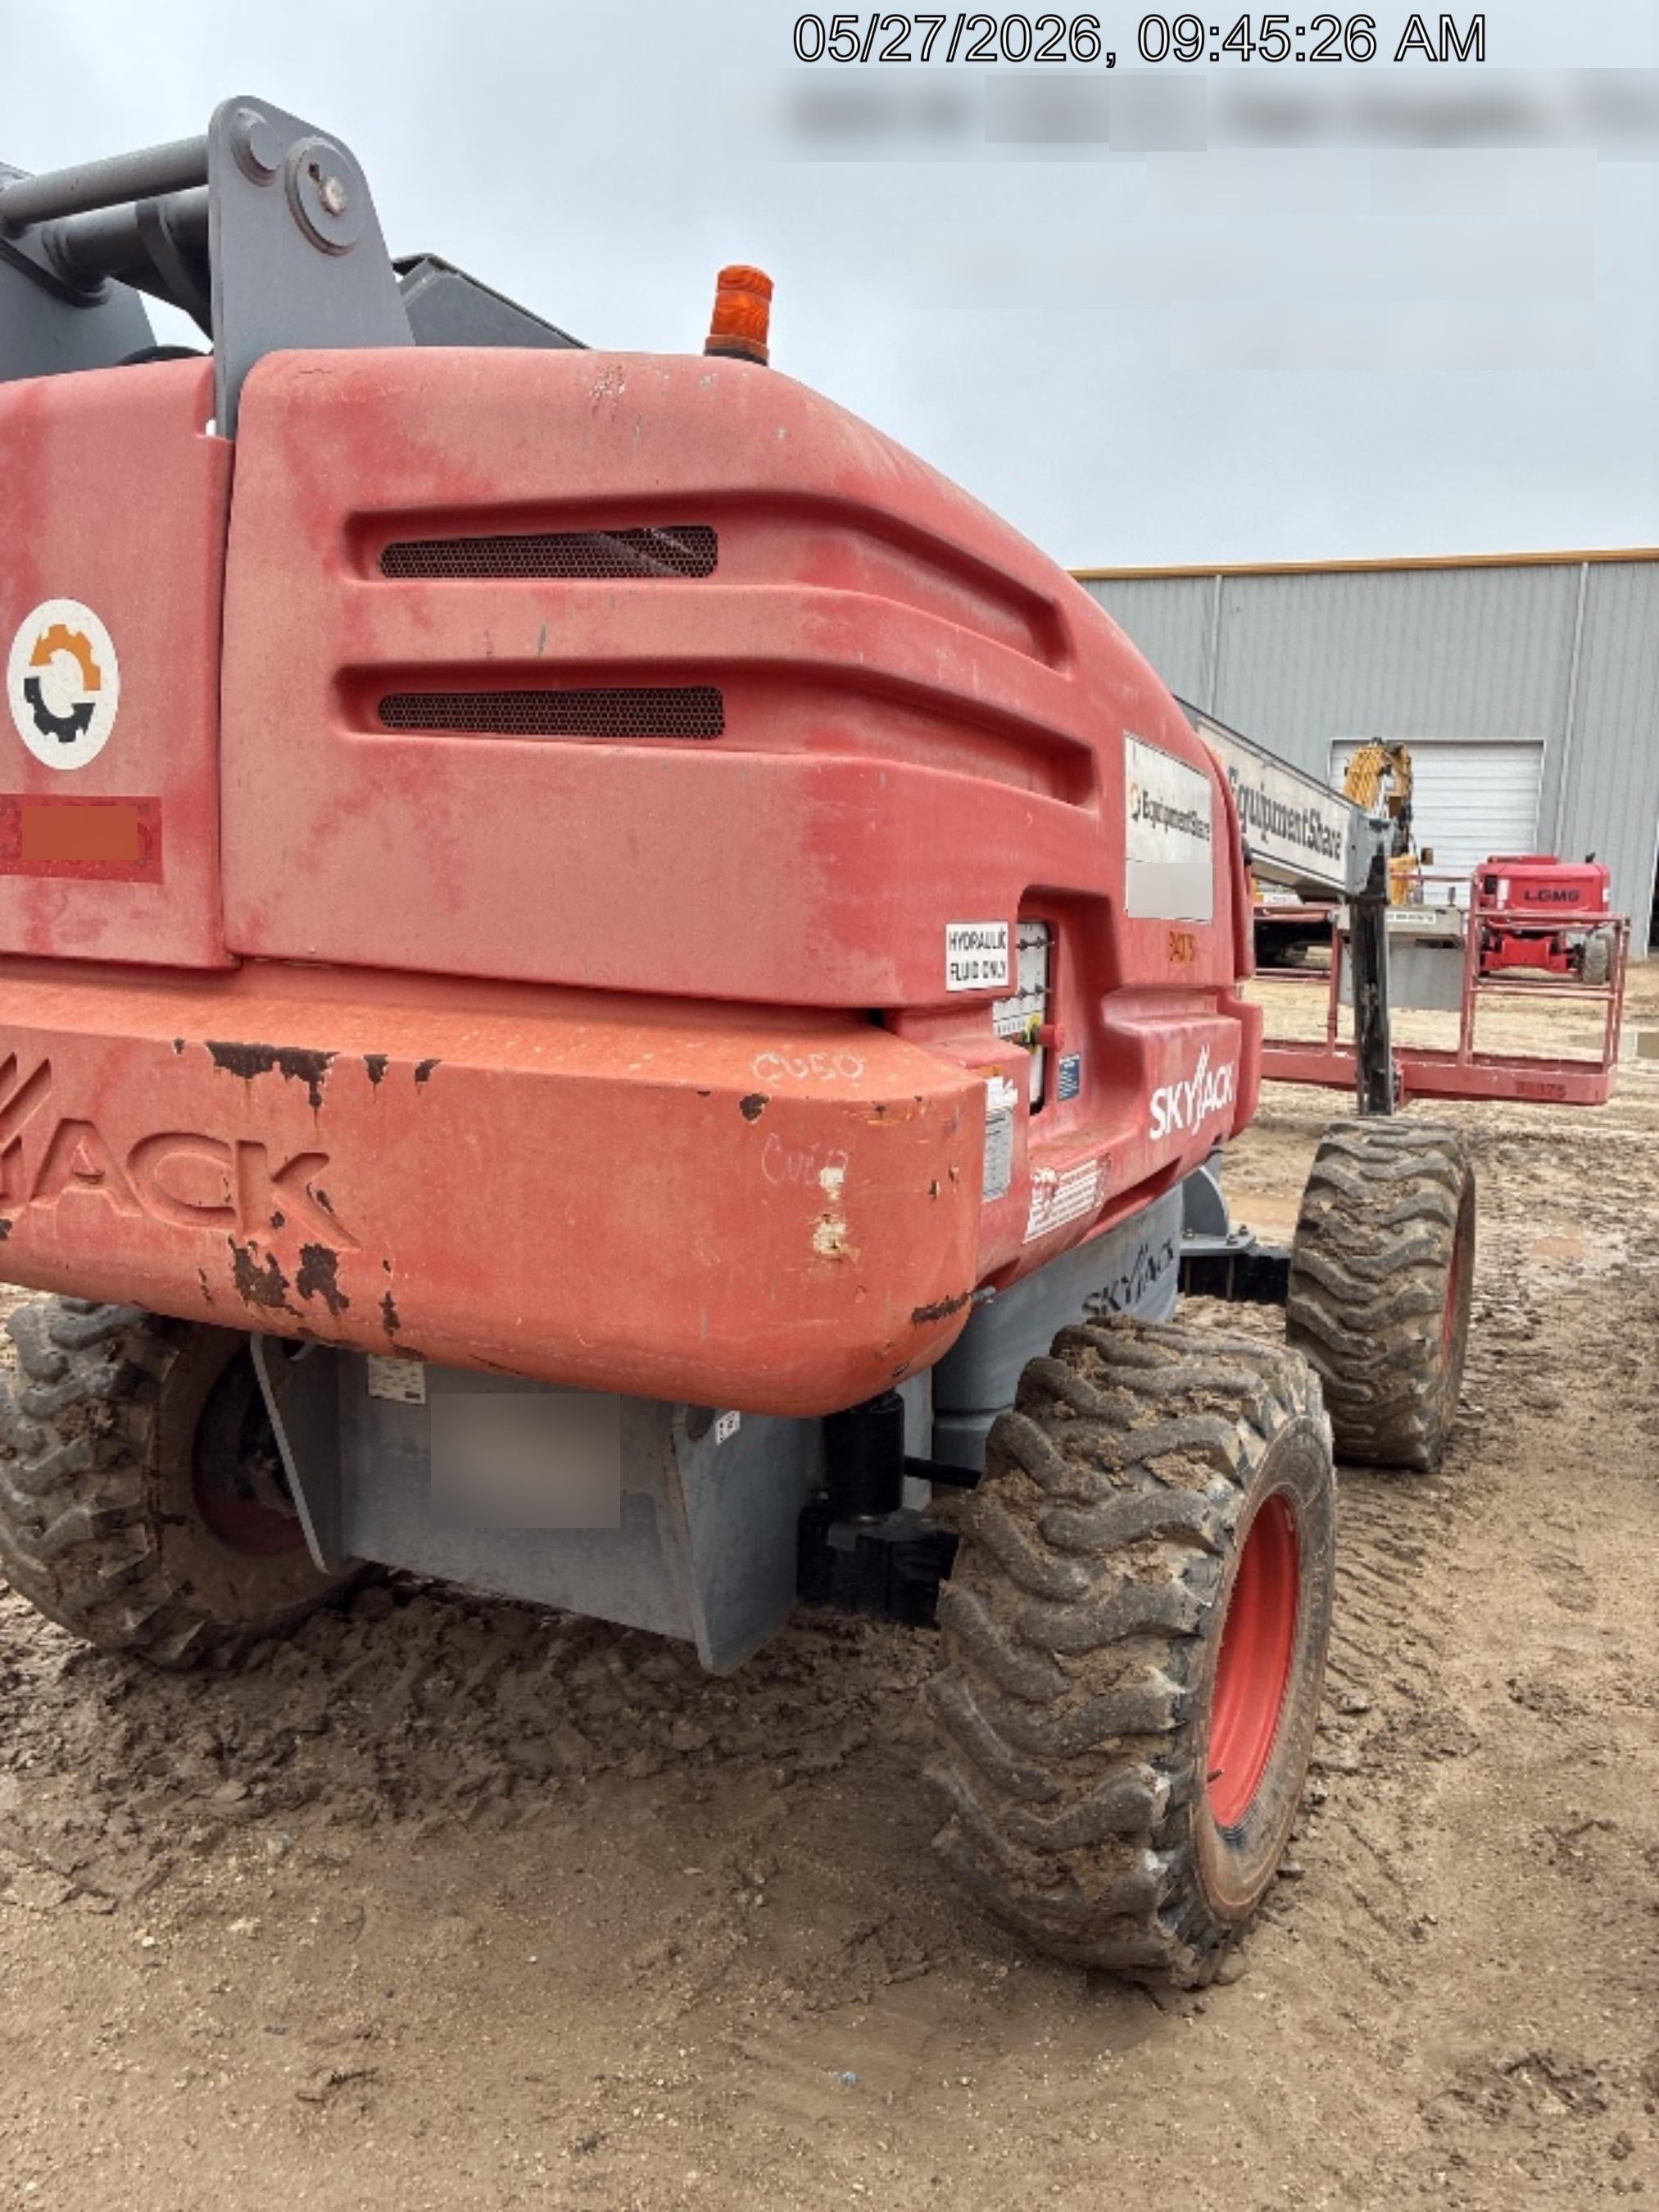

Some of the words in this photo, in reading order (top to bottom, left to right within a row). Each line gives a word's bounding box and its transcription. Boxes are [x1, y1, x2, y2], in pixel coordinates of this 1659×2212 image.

[1524, 889, 1580, 902] LGMG
[949, 929, 1006, 951] HYDRAULIC
[950, 960, 979, 981] FLUID
[982, 960, 1006, 979] ONLY
[1149, 1041, 1235, 1140] SKYJACK
